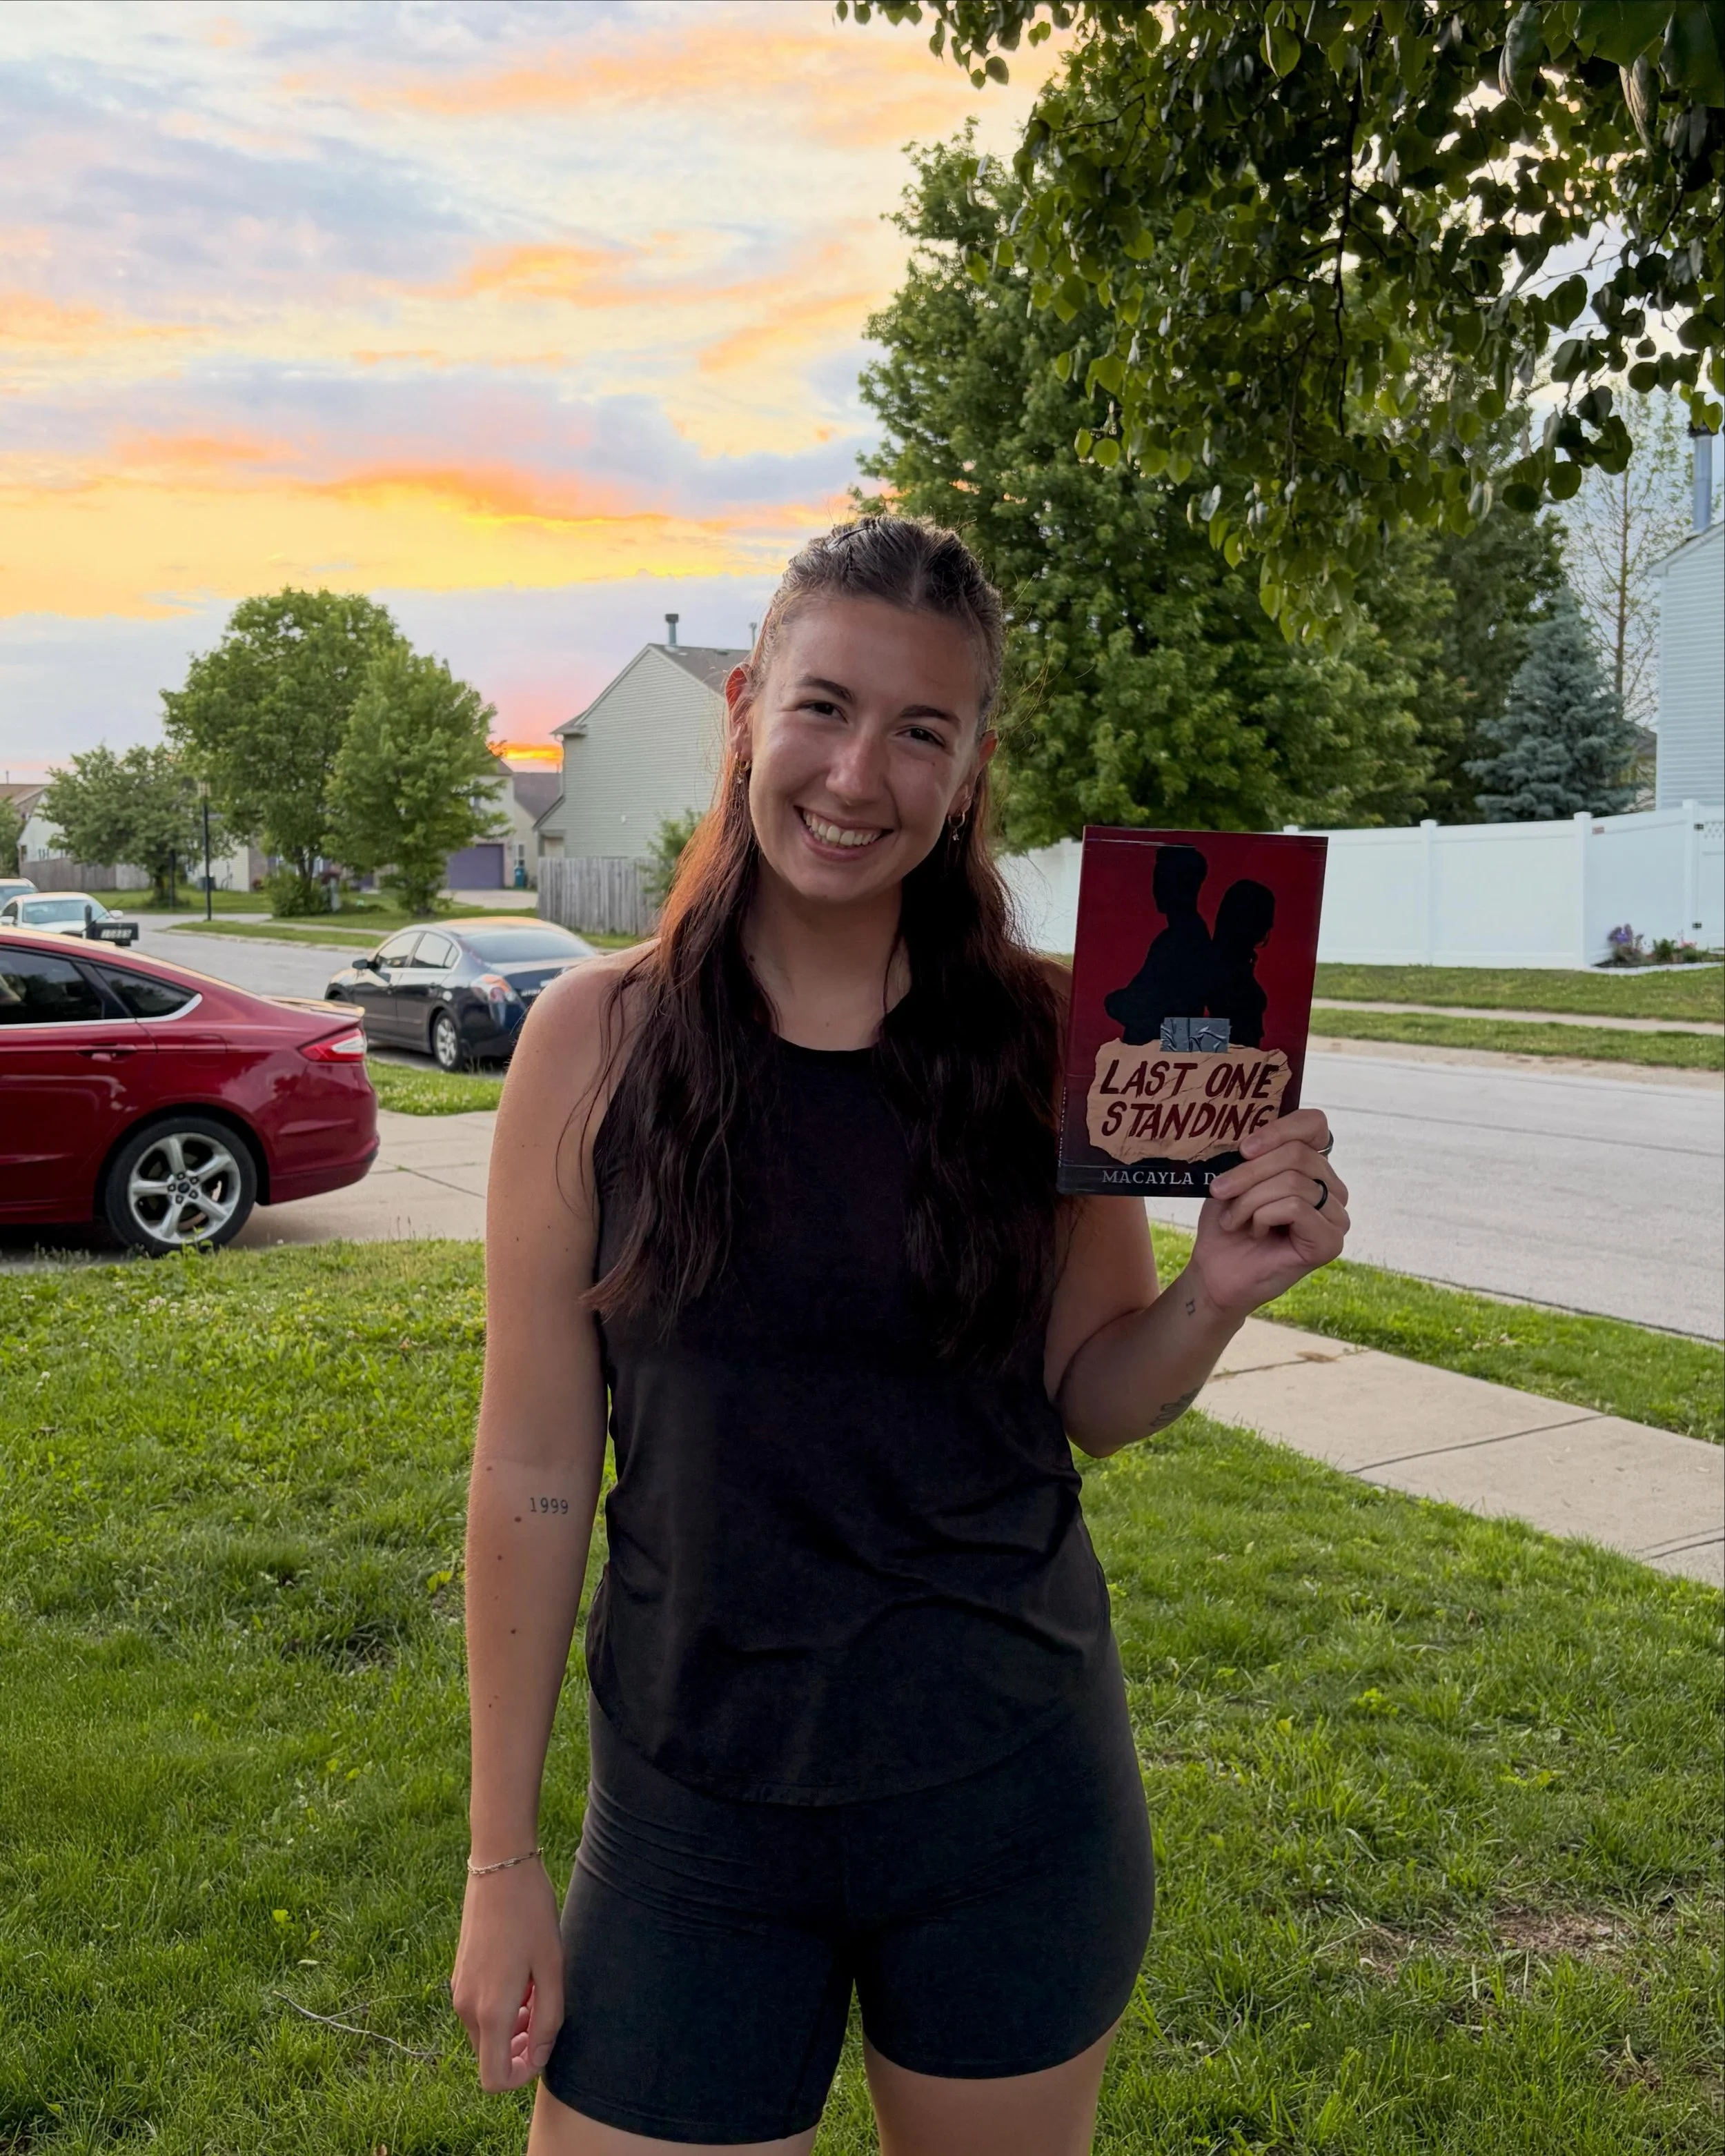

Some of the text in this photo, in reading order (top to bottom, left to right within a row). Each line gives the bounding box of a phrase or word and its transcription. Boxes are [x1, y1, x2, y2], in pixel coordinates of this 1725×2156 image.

[1100, 1060, 1279, 1099] LAST ONE
[1101, 1170, 1194, 1185] MACAYLA
[529, 1496, 569, 1515] 1999
